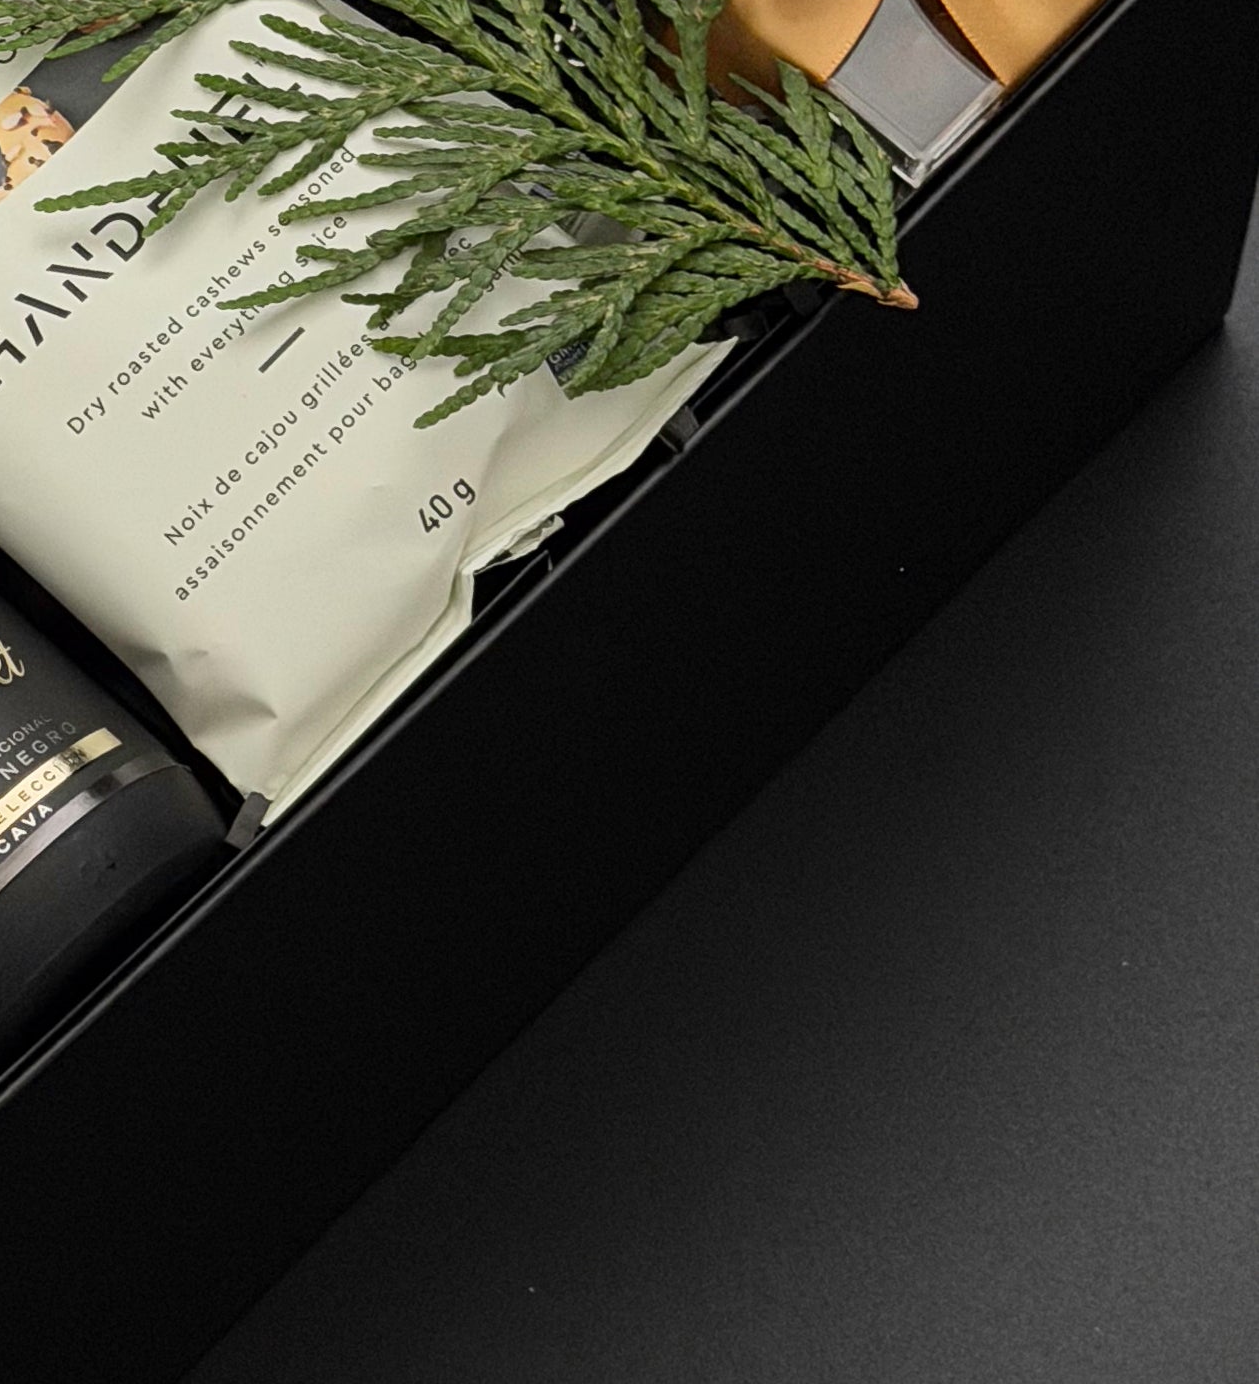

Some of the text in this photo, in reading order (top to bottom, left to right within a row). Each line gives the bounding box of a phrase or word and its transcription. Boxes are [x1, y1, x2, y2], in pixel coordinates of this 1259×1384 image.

[67, 396, 108, 436] Dry
[108, 317, 185, 396] roasted
[186, 240, 267, 318] cashews
[142, 216, 348, 420] with everytg sice
[163, 496, 214, 546] Noix
[214, 464, 243, 497] de
[244, 410, 299, 470] cajou
[300, 333, 374, 410] grillées
[174, 438, 329, 603] assaisonnement
[328, 390, 376, 445] pour
[416, 476, 477, 535] 40 g
